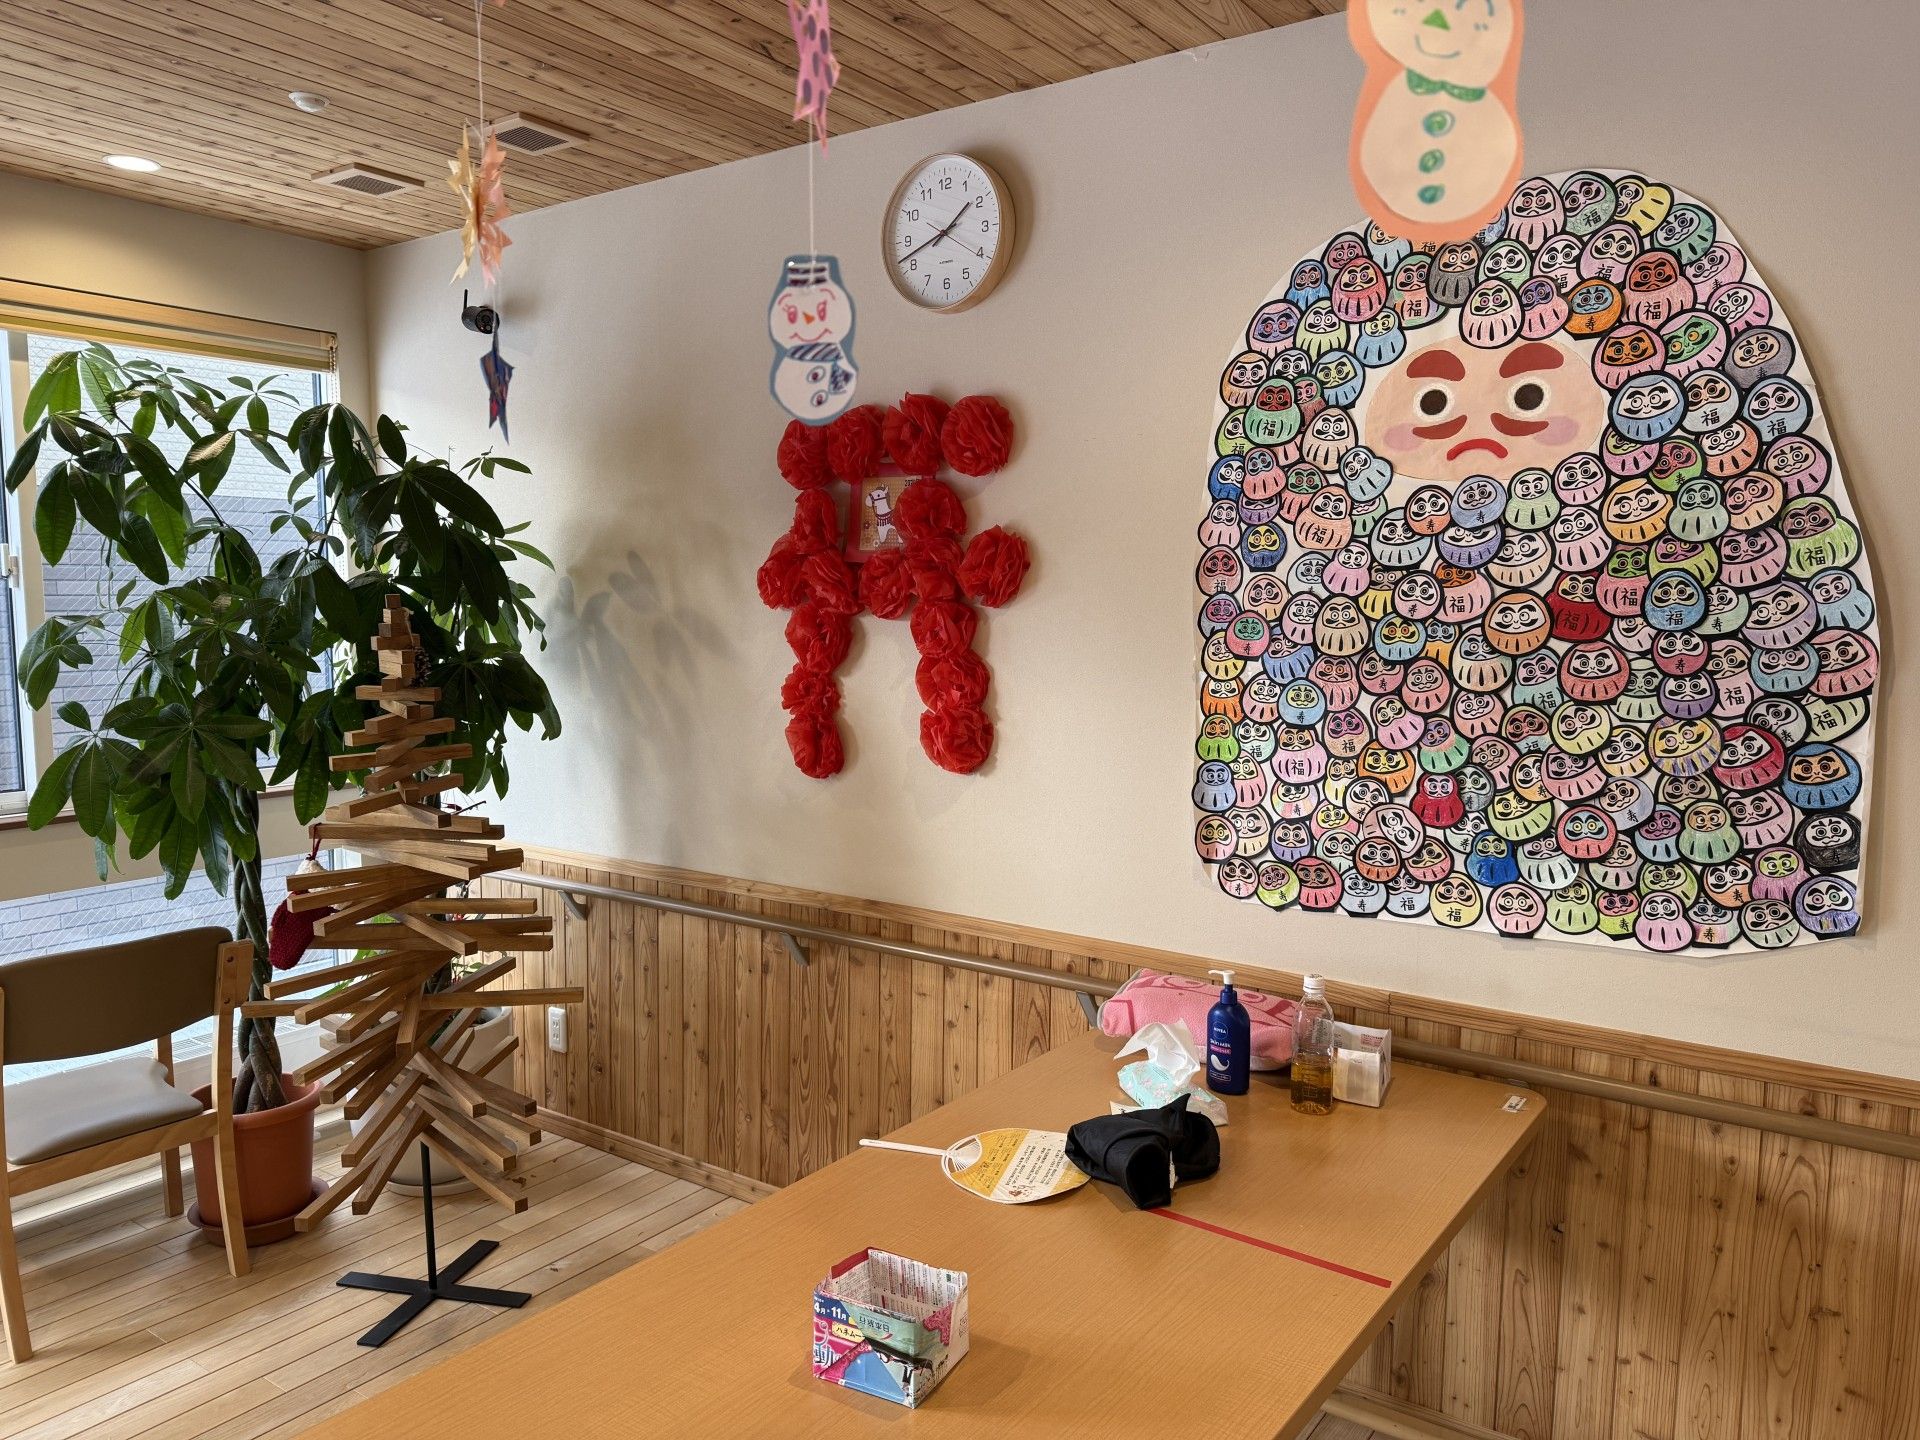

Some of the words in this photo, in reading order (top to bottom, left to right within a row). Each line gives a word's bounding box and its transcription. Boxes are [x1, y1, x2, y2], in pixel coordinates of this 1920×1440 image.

[938, 178, 952, 190] 12
[962, 180, 968, 191] 1
[921, 188, 932, 200] 11
[976, 196, 983, 208] 2
[907, 210, 919, 222] 10
[1583, 210, 1602, 226] 福
[982, 220, 989, 232] 3
[905, 236, 912, 247] 9
[976, 247, 984, 258] 4
[910, 259, 917, 270] 8
[962, 268, 969, 280] 5
[1596, 264, 1614, 281] 福
[925, 275, 931, 286] 7
[944, 278, 950, 290] 6
[1555, 274, 1568, 289] 福
[1407, 300, 1422, 317] 福
[1644, 302, 1661, 320] 福
[1585, 318, 1595, 330] 寿
[1701, 408, 1720, 426] 福
[1262, 420, 1276, 436] 福
[1767, 418, 1786, 436] 福
[1231, 442, 1244, 455] 福
[1675, 473, 1685, 485] 寿
[1476, 510, 1485, 523] 寿
[1426, 520, 1434, 530] 寿
[1311, 528, 1328, 544] 福
[1804, 546, 1825, 566] 福
[1214, 579, 1226, 592] 福
[1622, 588, 1637, 606] 福
[1408, 603, 1417, 616] 寿
[1449, 596, 1465, 612] 福
[1565, 613, 1580, 630] 福
[1666, 611, 1682, 626] 福
[1712, 618, 1722, 632] 寿
[1674, 659, 1686, 674] 寿
[1379, 678, 1388, 692] 寿
[1538, 693, 1556, 709] 福
[1725, 687, 1745, 706] 福
[1814, 712, 1837, 730] 福
[1782, 730, 1794, 743] 寿
[1250, 745, 1262, 757] 福
[1342, 740, 1355, 752] 福
[1291, 760, 1304, 776] 福
[1537, 786, 1546, 798] 寿
[1626, 810, 1638, 822] 寿
[1234, 883, 1242, 895] 寿
[1733, 890, 1743, 902] 寿
[1358, 900, 1366, 912] 寿
[1400, 898, 1414, 911] 福
[1447, 908, 1462, 922] 福
[1620, 918, 1629, 932] 寿
[1704, 928, 1714, 942] 寿
[836, 1327, 865, 1338] ハネムー
